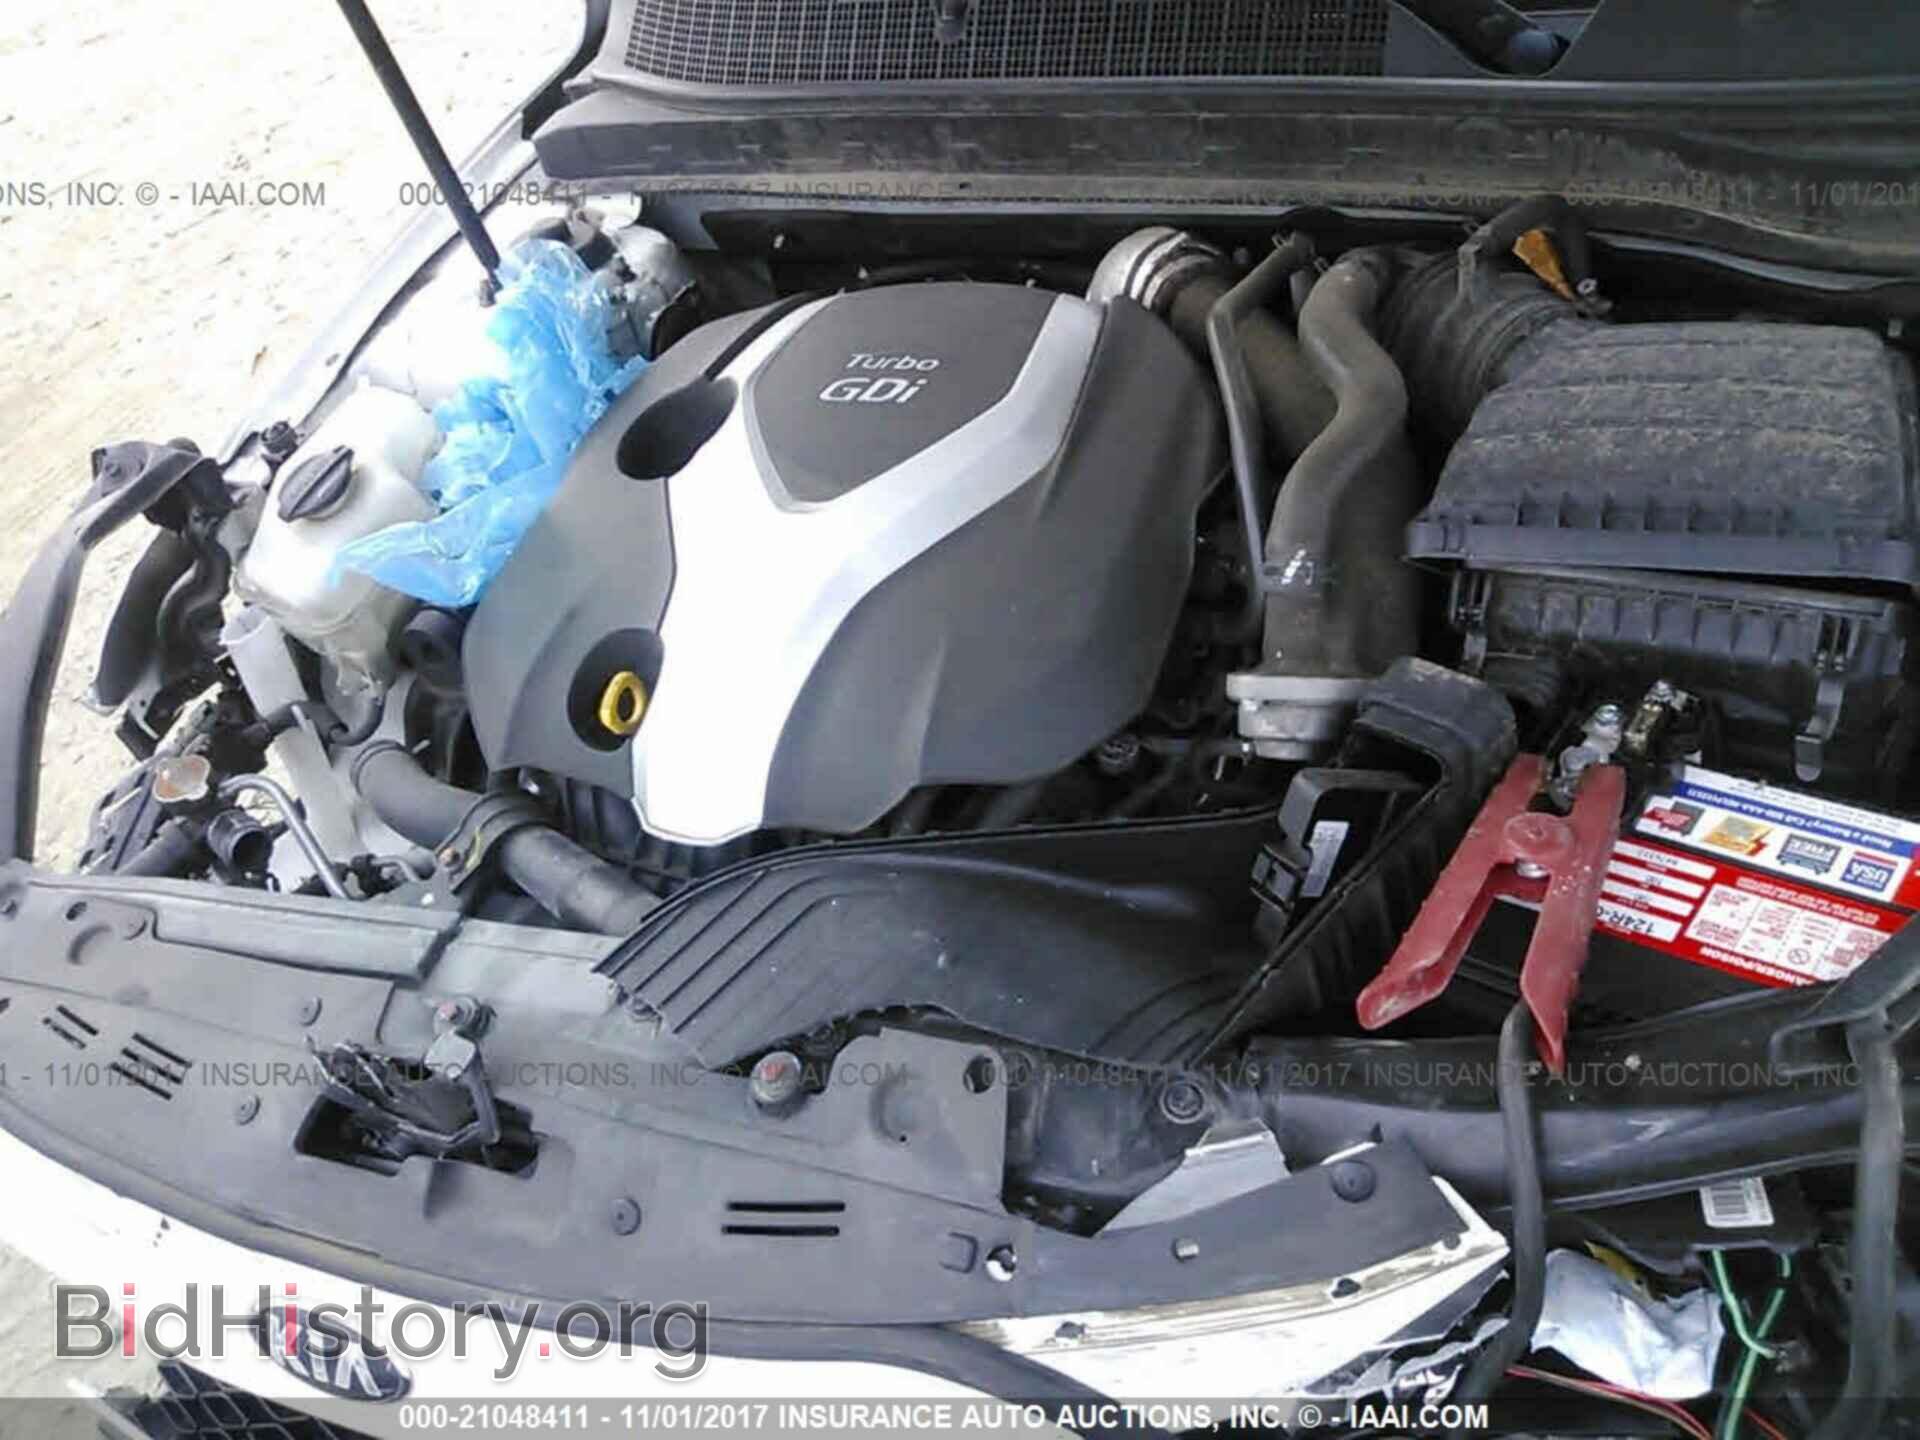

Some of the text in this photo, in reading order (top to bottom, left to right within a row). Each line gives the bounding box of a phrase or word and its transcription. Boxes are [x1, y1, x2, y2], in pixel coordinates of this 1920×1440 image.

[847, 353, 940, 372] Turbo
[819, 376, 929, 403] GDi
[1850, 862, 1889, 884] USA
[268, 1311, 384, 1398] KIA
